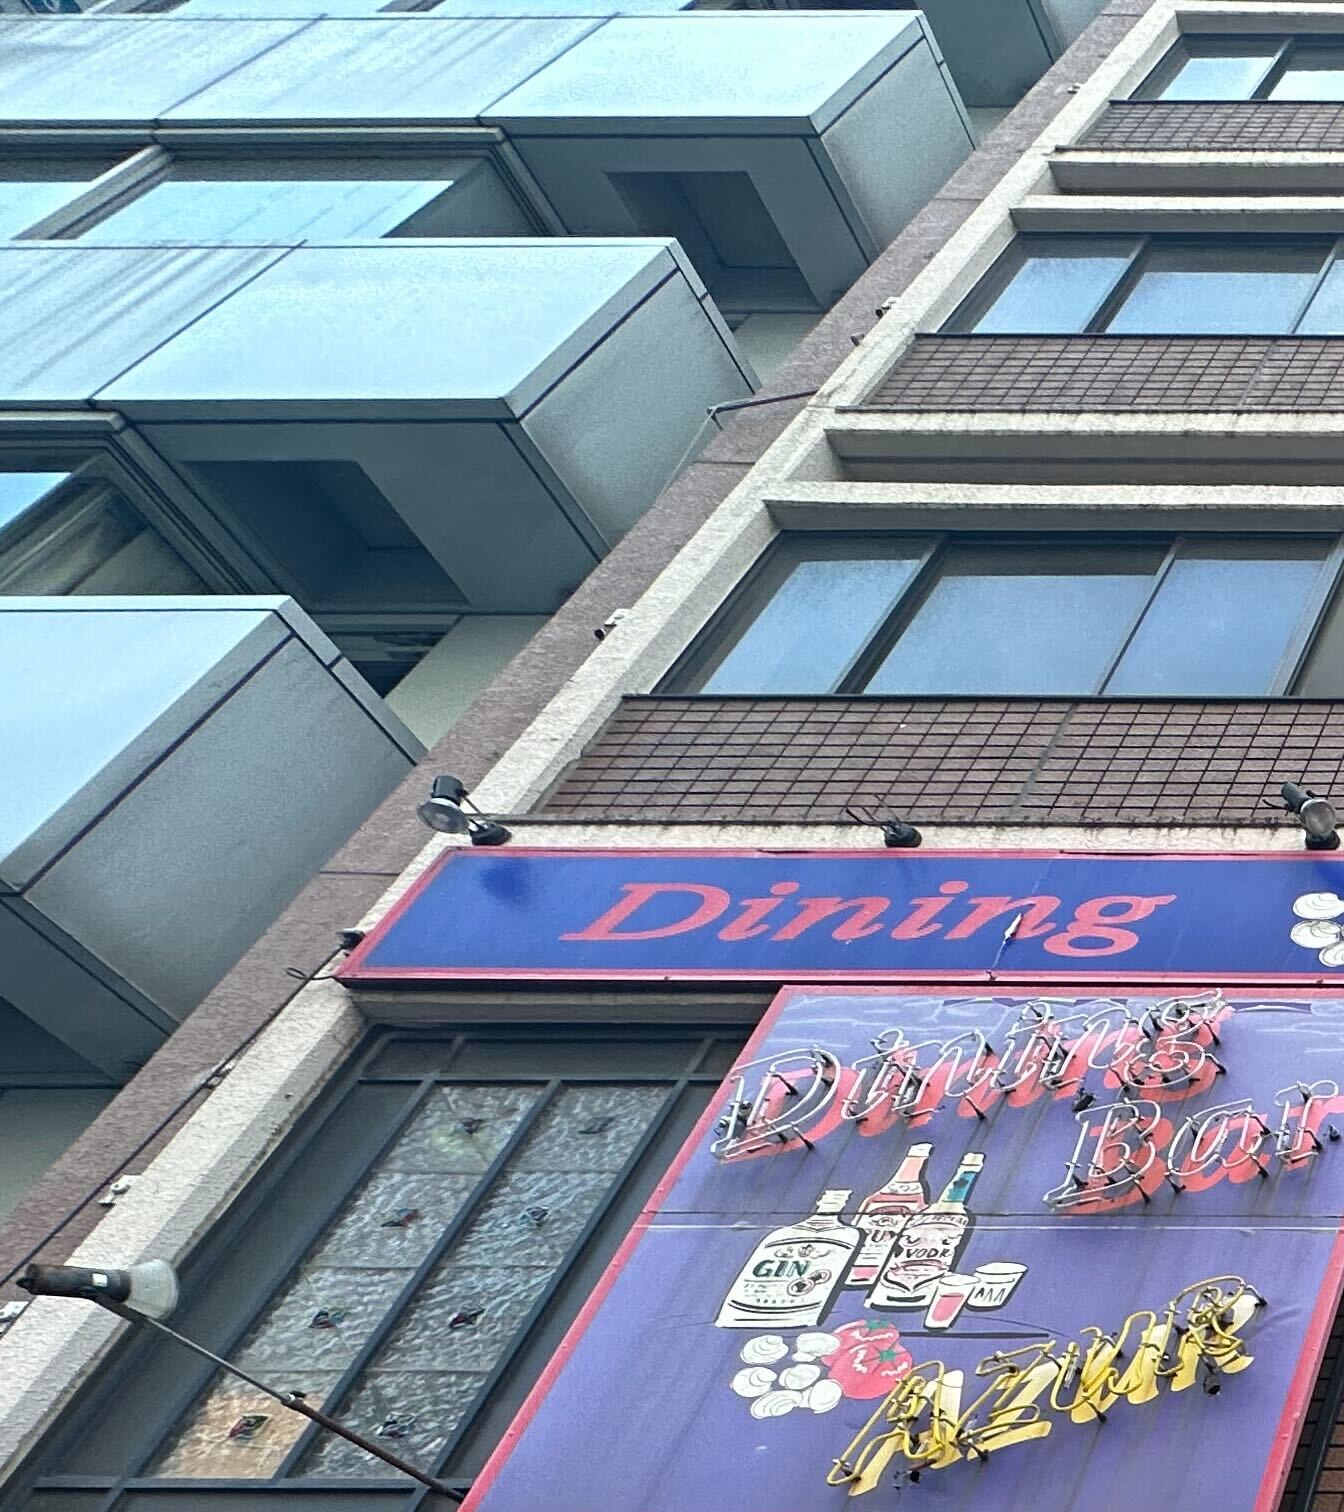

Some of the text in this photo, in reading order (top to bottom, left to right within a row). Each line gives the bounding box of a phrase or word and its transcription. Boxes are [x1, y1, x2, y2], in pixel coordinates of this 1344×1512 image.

[559, 880, 1178, 957] Dining
[709, 988, 1234, 1163] Dining
[752, 1258, 811, 1279] GIN
